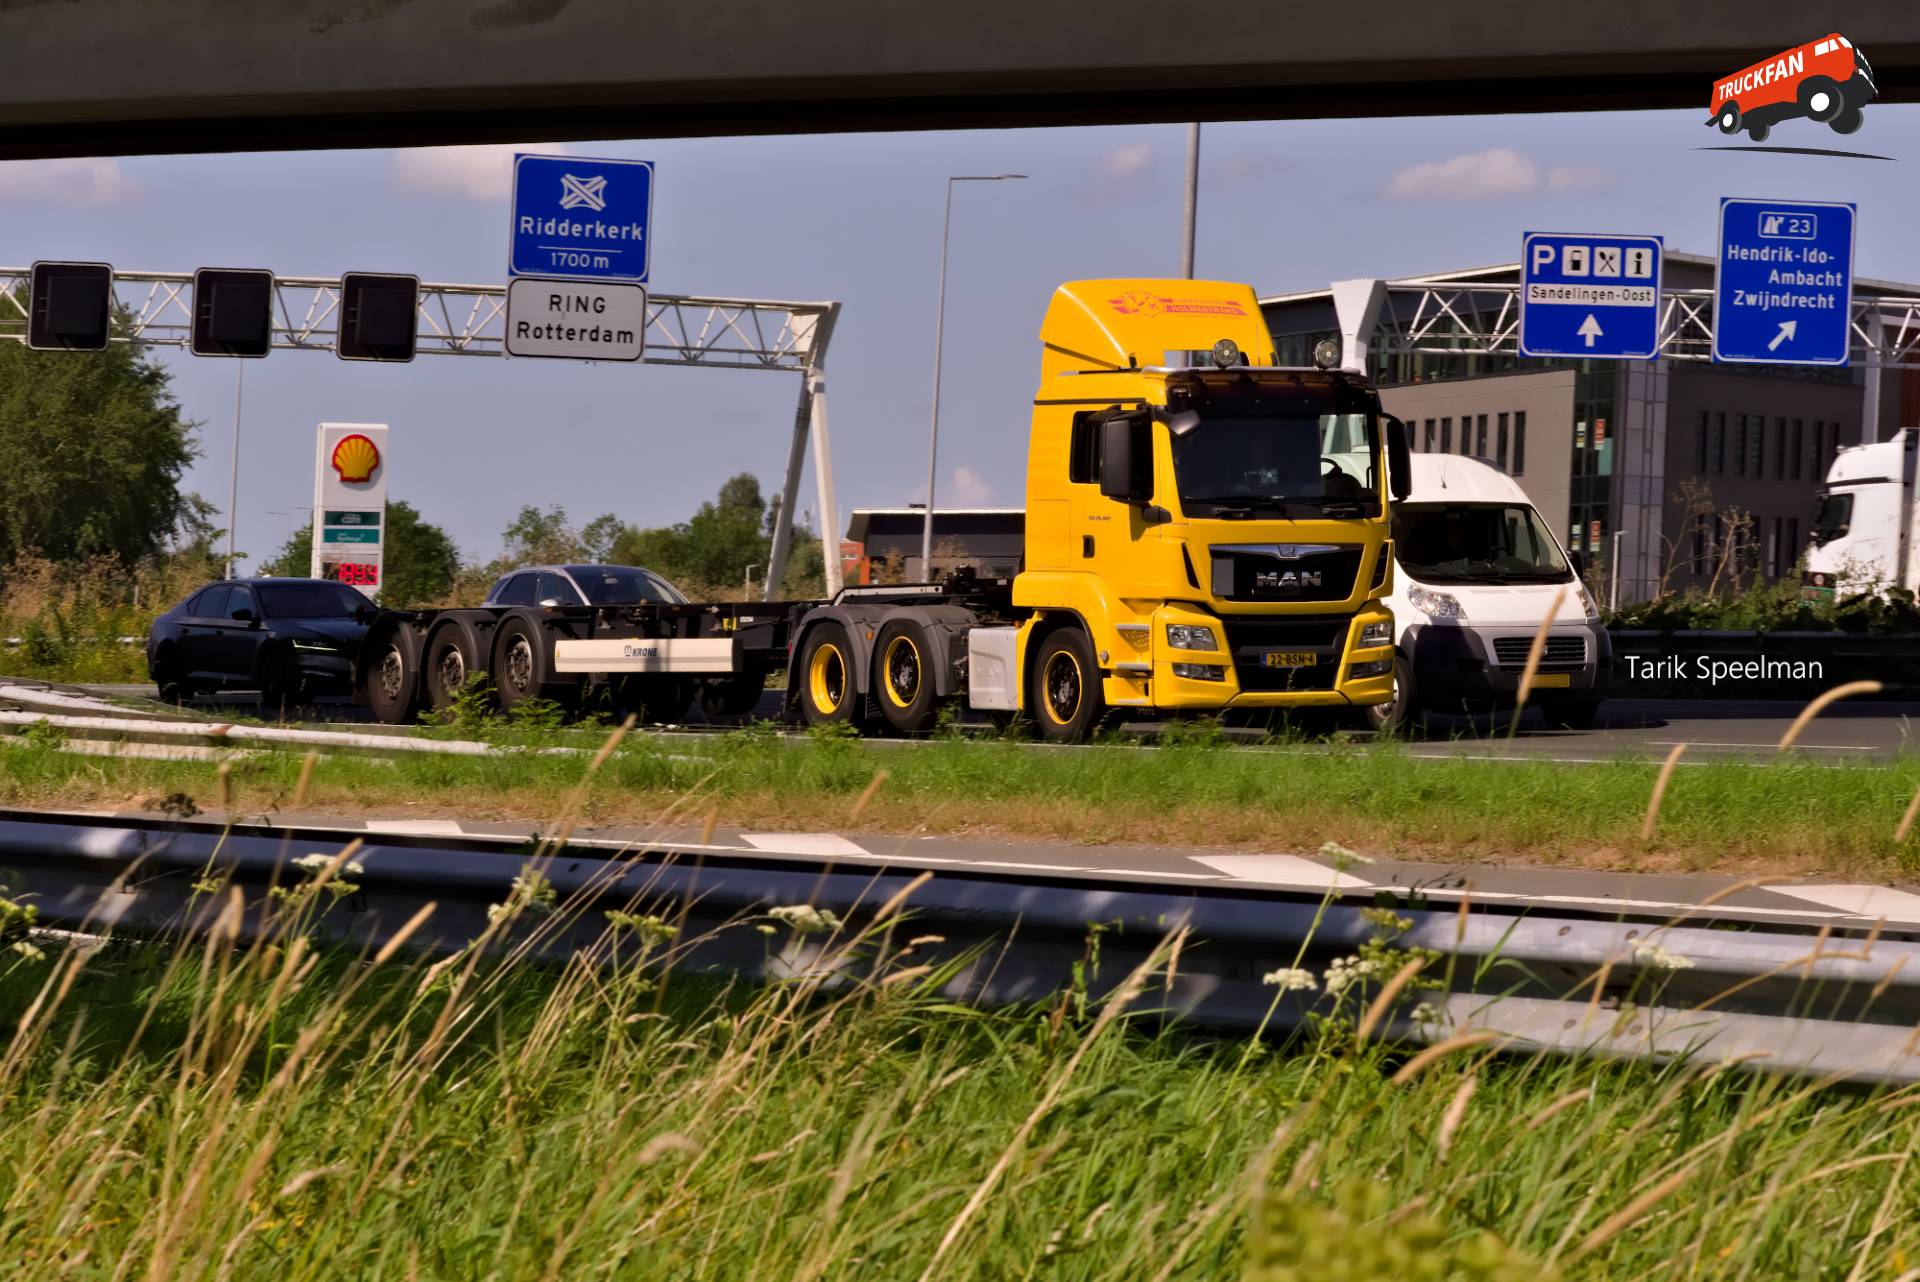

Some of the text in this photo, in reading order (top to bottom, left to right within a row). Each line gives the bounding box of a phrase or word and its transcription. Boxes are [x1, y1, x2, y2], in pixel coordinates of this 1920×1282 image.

[520, 216, 643, 241] Ridderkerk
[1788, 219, 1811, 234] 23
[551, 252, 609, 269] 1700 m
[1532, 244, 1556, 275] P
[1727, 244, 1836, 264] Hendrik-Ido-
[1768, 269, 1843, 287] Ambacht
[549, 294, 606, 314] RING
[1531, 286, 1651, 304] Sandelingen-Oost
[1733, 290, 1835, 311] Zwijndrecht
[517, 321, 634, 344] Rotterdam
[1256, 571, 1321, 586] MAN
[632, 647, 658, 657] KRONE
[1269, 653, 1314, 665] 22-BSN-4
